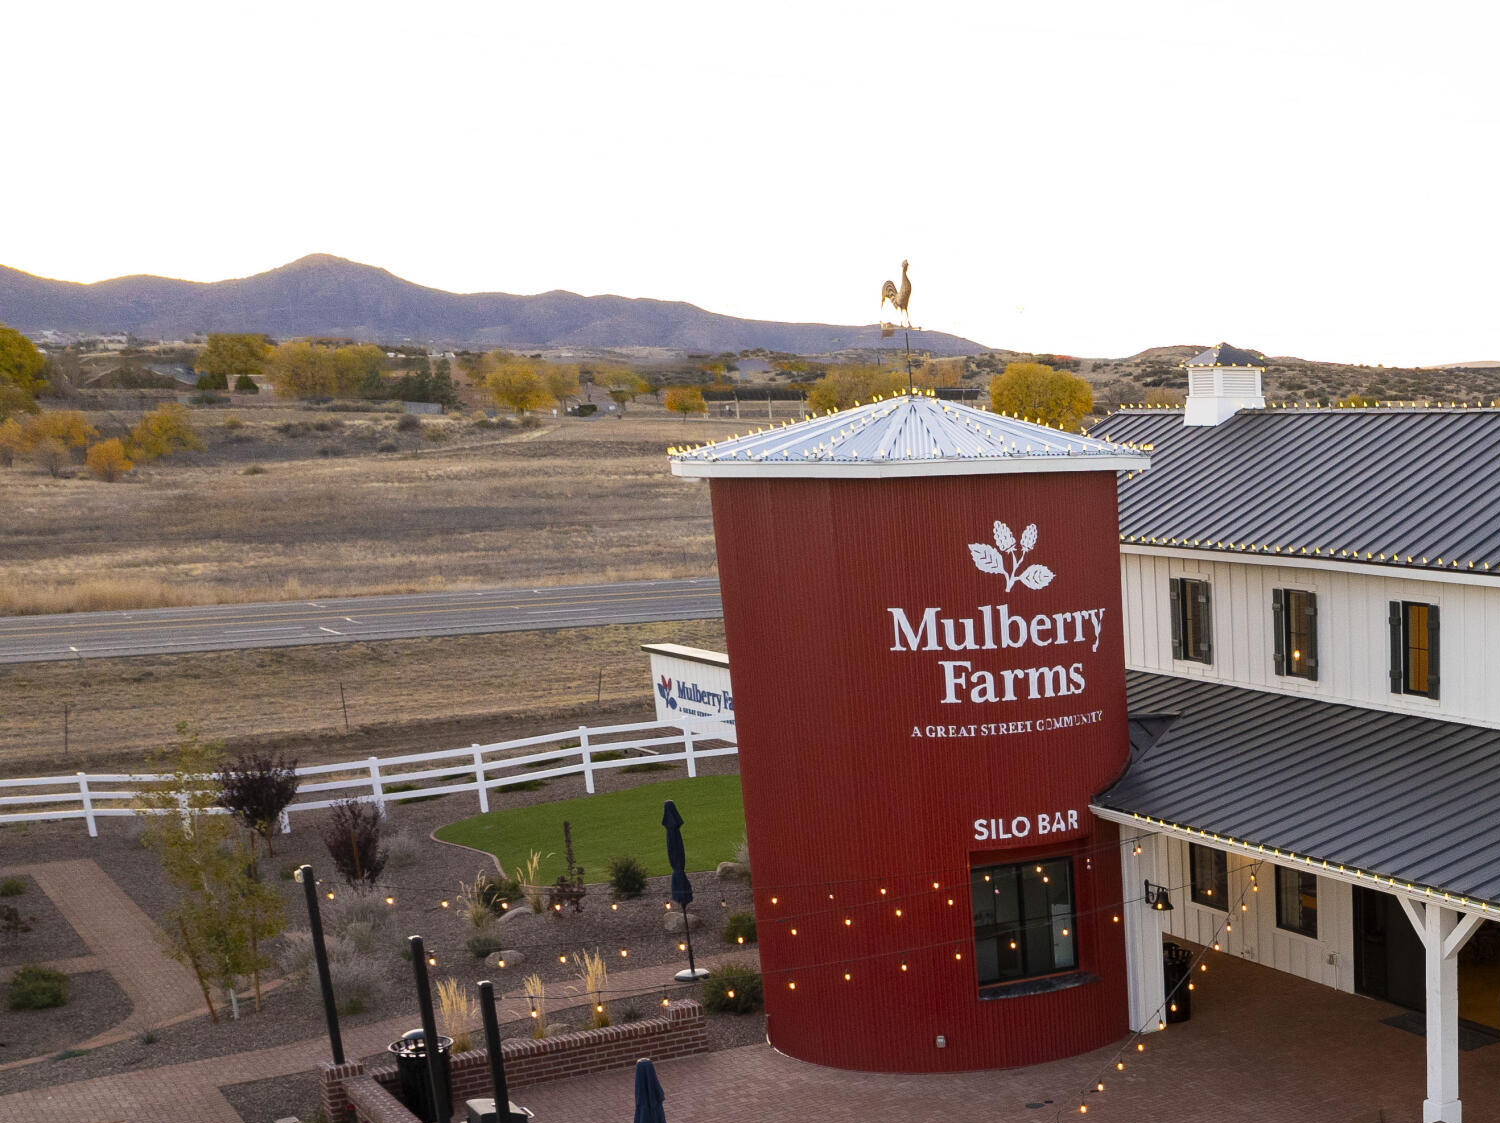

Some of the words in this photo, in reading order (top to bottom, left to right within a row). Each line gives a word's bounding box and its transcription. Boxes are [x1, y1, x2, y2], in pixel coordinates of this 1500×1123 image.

[887, 604, 1105, 652] Mulberry
[677, 680, 721, 713] Mulberry
[938, 661, 1085, 704] Farms
[911, 727, 922, 738] A
[926, 725, 977, 738] GREAT
[981, 720, 1033, 736] STREET
[1036, 710, 1103, 731] COMMUNITY
[974, 816, 1031, 841] SILO
[1037, 810, 1079, 835] BAR
